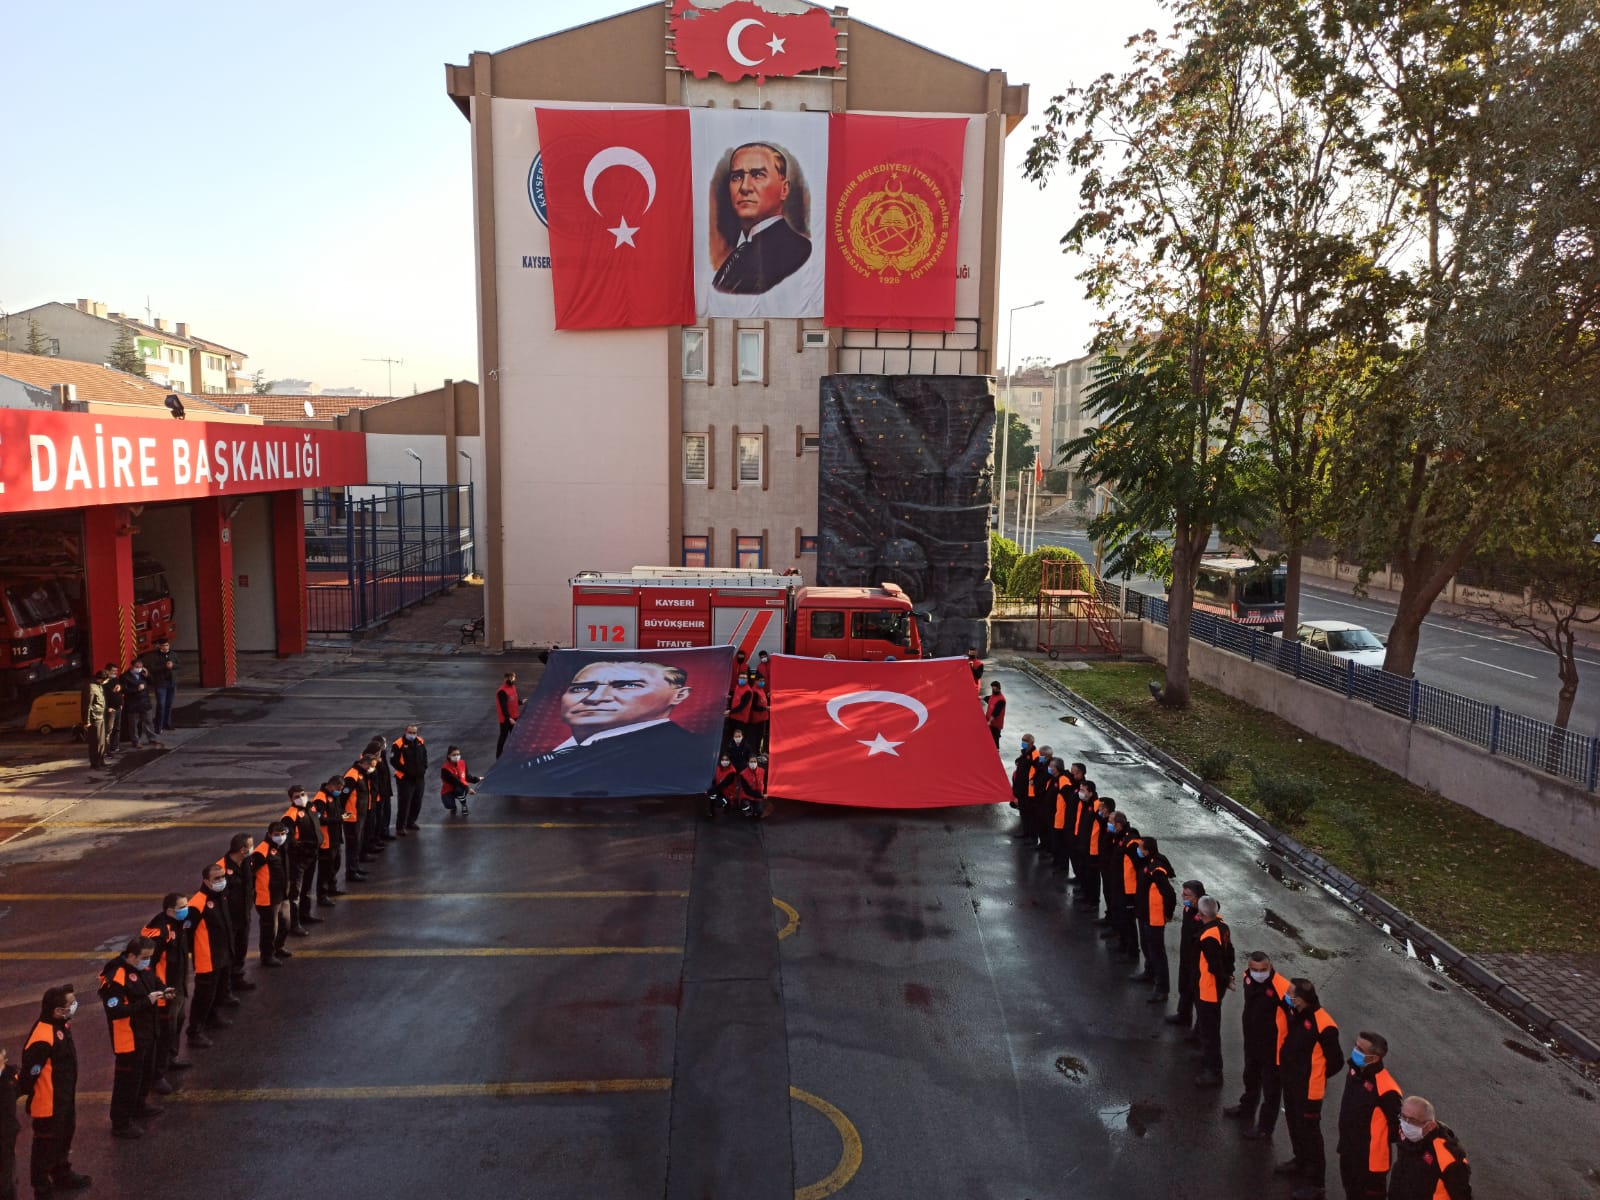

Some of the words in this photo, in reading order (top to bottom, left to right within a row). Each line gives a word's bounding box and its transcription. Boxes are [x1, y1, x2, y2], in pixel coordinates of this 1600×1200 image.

[535, 163, 546, 208] KAYSER
[522, 255, 552, 269] KAYSER
[956, 264, 970, 279] LIĞI
[29, 423, 160, 492] DAİRE
[172, 434, 321, 489] BAŞKANLIĞI
[588, 624, 625, 643] 112
[12, 646, 28, 656] 112
